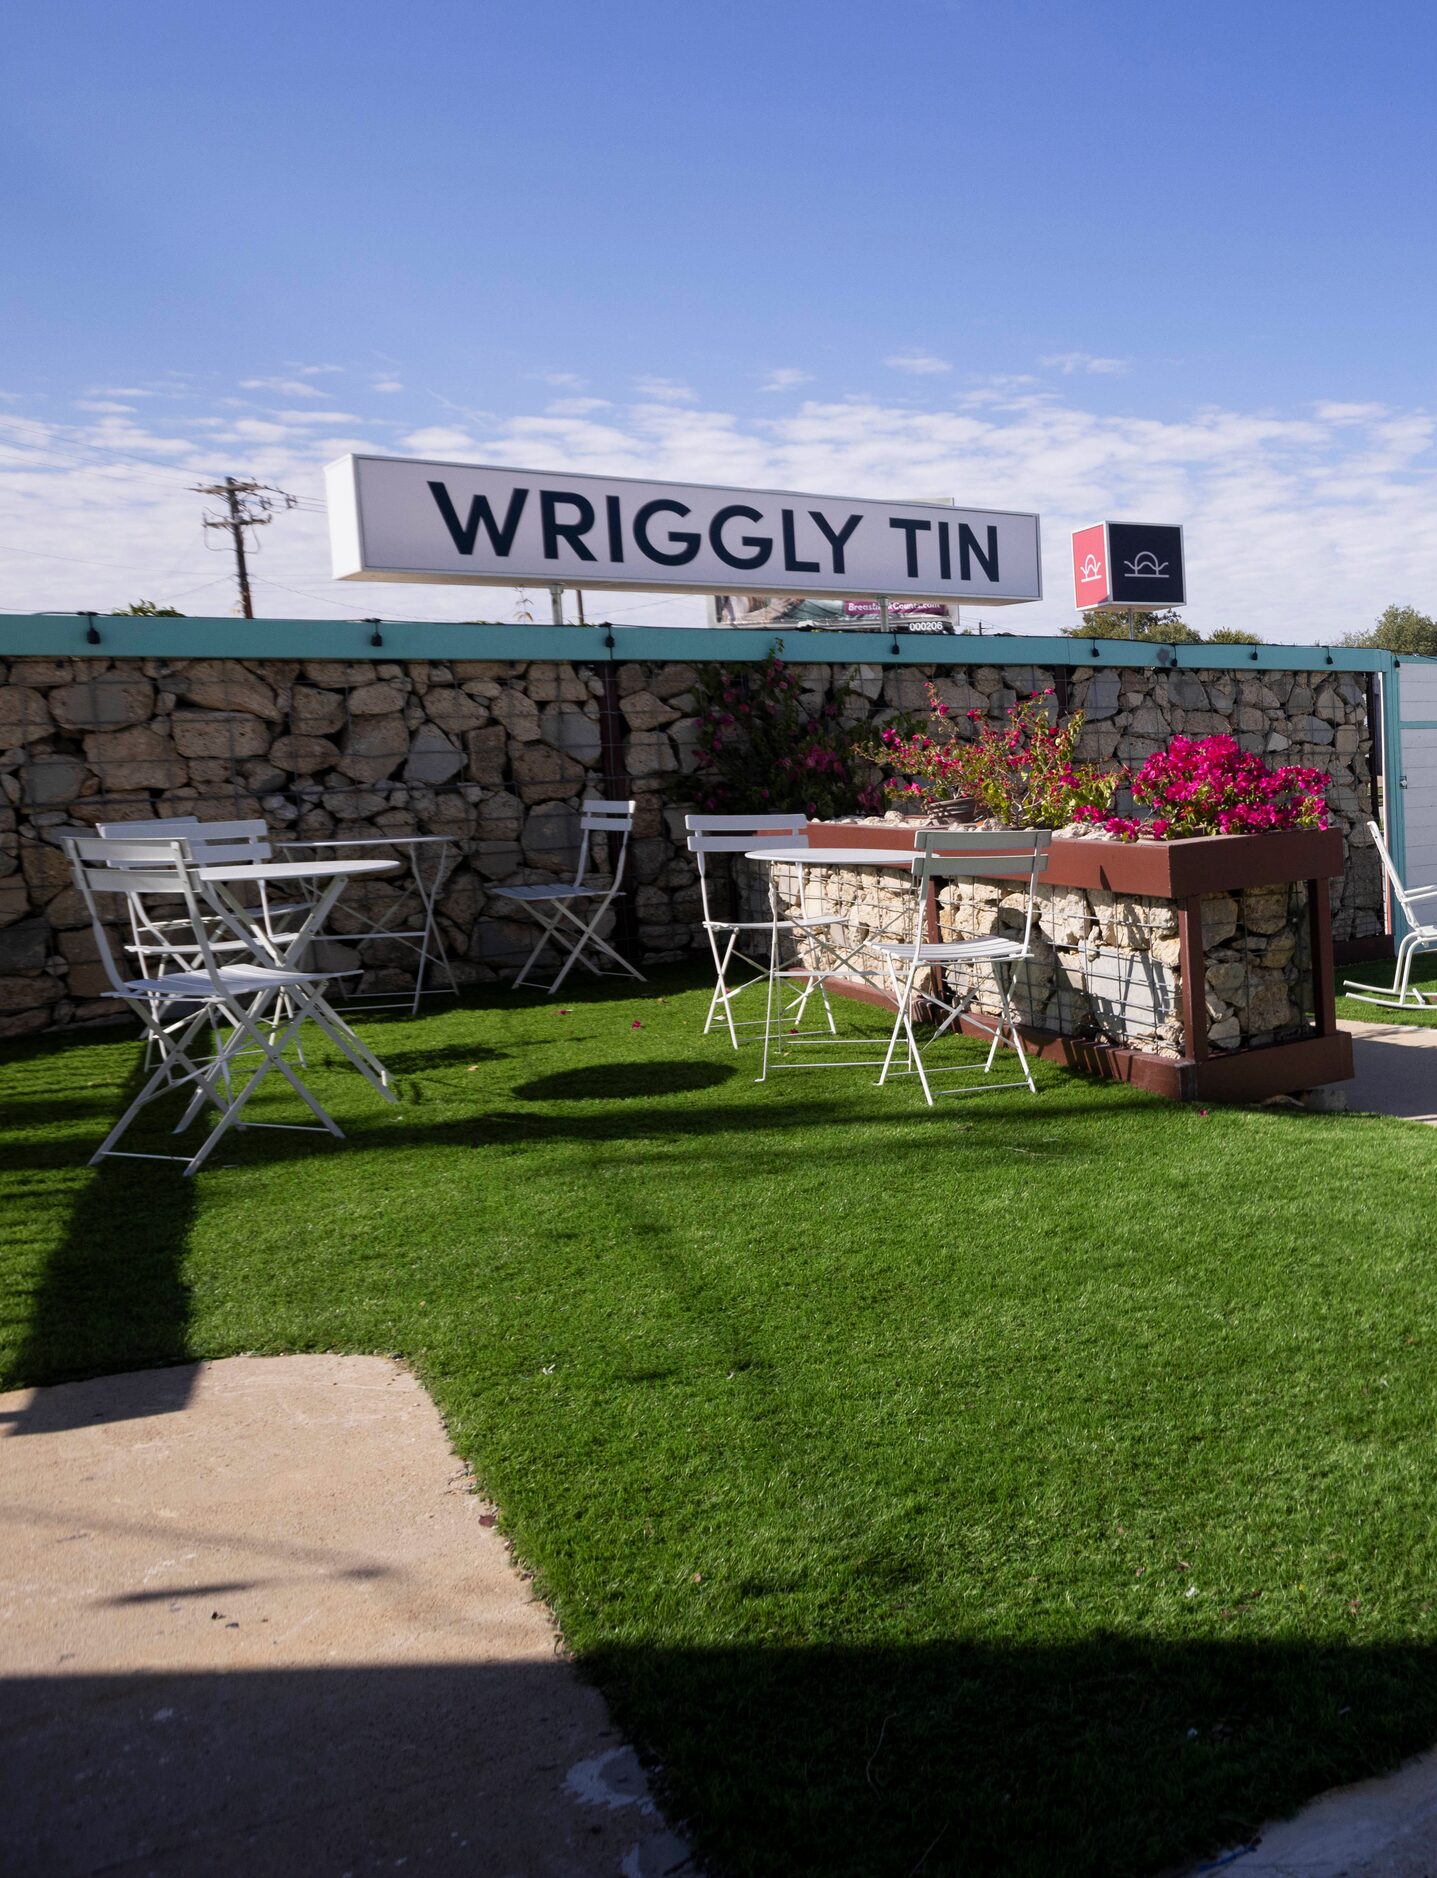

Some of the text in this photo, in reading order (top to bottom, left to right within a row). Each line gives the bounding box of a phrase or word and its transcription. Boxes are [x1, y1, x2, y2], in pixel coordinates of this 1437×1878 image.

[426, 480, 1000, 583] WRIGGLY TIN
[909, 622, 943, 631] 000206
